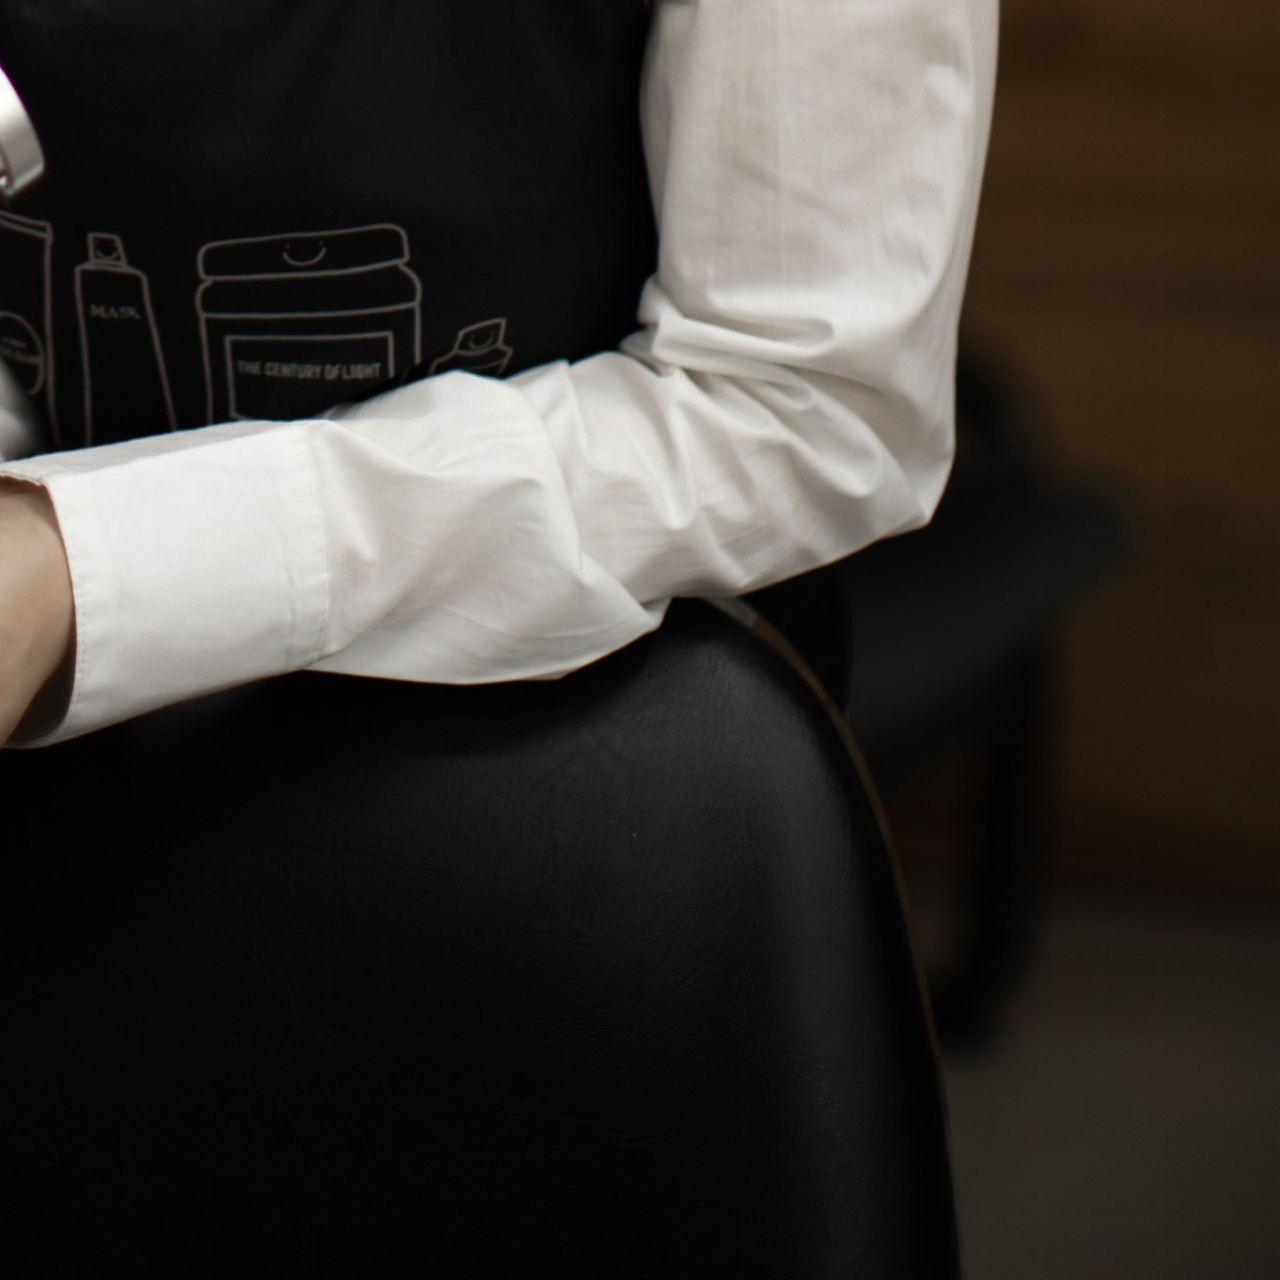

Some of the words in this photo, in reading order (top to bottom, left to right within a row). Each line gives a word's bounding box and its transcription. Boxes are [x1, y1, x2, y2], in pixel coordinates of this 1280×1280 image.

[237, 361, 261, 375] THE
[264, 362, 322, 379] CENTURY
[324, 364, 341, 380] OF
[342, 362, 381, 380] LIGHT
